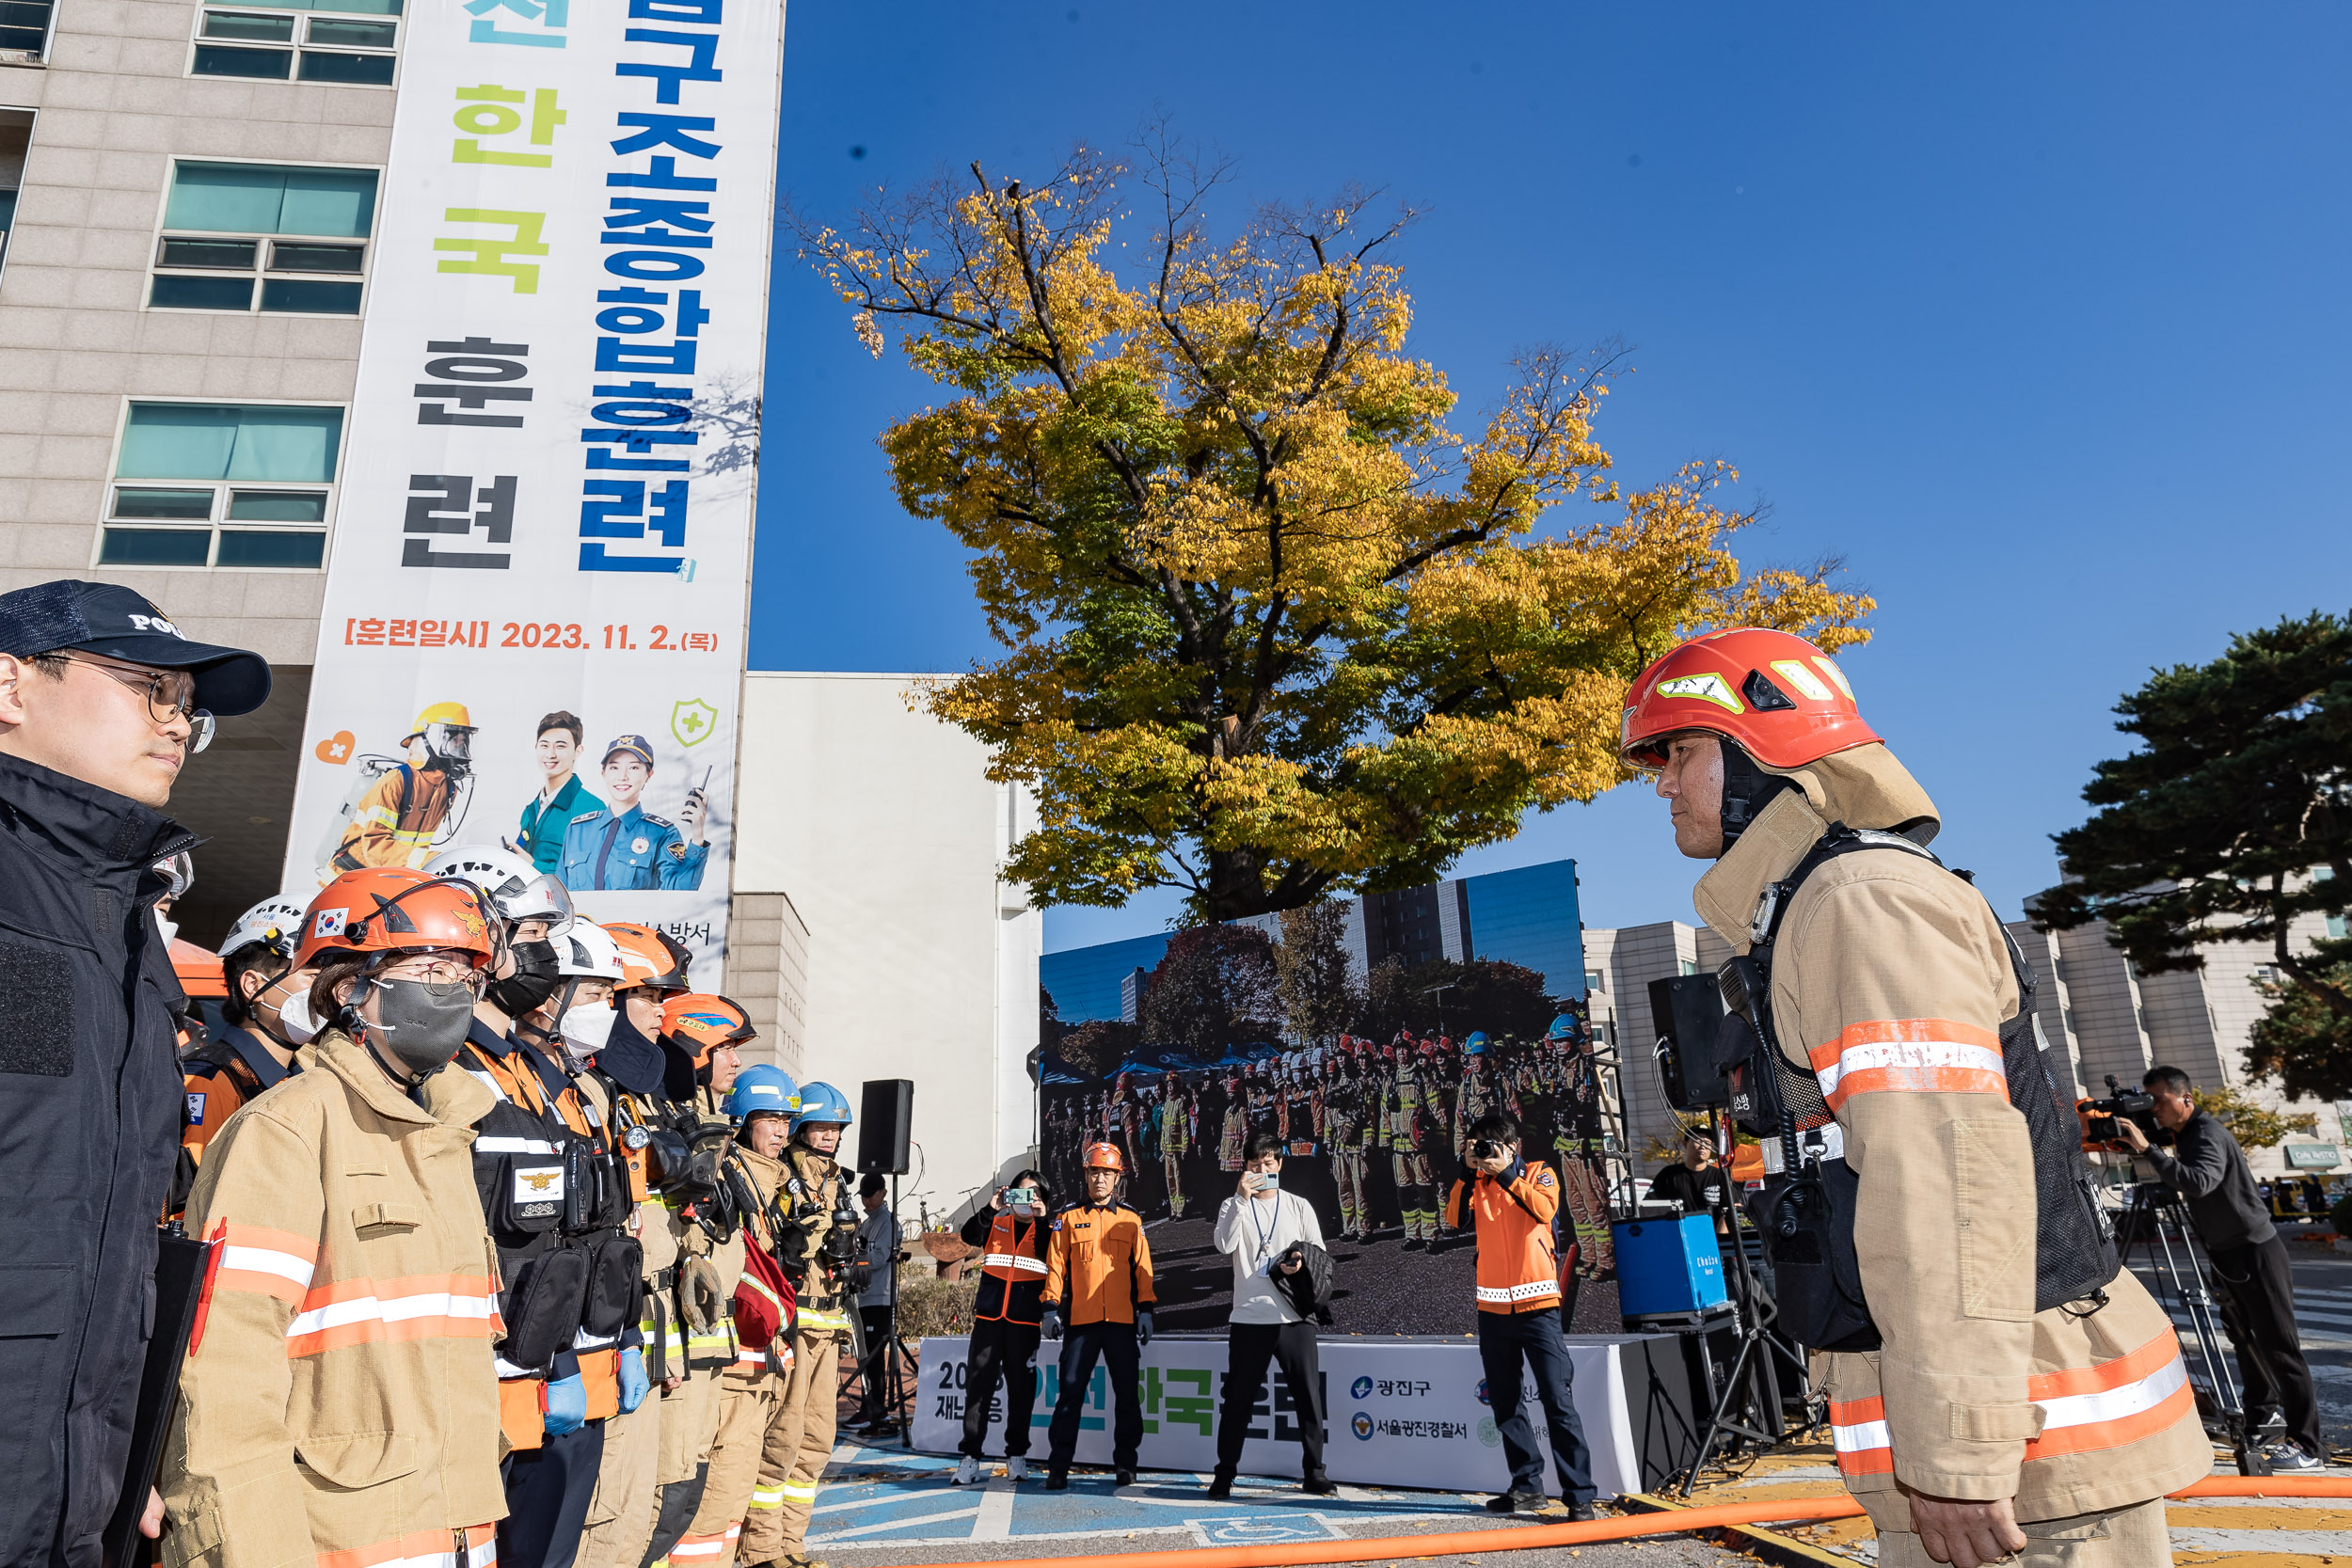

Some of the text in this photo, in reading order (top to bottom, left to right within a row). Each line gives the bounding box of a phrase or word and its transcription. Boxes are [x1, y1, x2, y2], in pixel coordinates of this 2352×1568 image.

[344, 617, 489, 648] [훈련일시]
[501, 622, 590, 650] 2023.
[603, 625, 637, 651] 11.
[1376, 1380, 1431, 1397] 광진구
[1376, 1418, 1467, 1439] 서울광진경찰서
